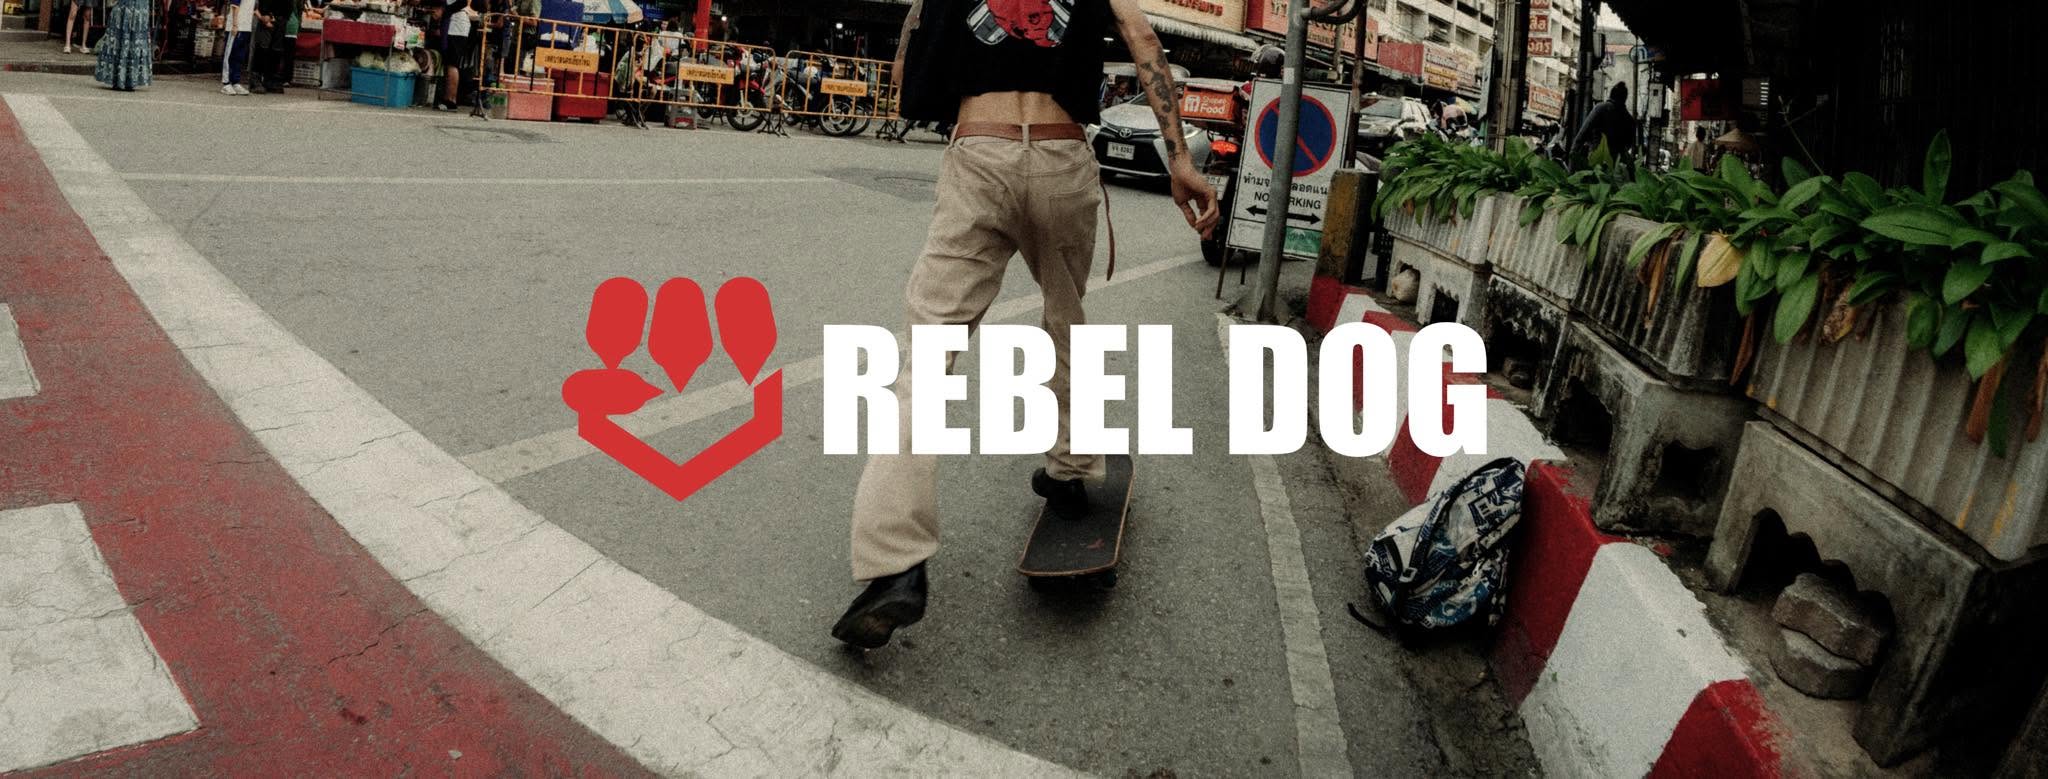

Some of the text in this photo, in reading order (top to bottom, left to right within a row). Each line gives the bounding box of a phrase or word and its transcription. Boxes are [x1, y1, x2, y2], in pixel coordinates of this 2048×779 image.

[1200, 103, 1226, 114] Food
[1254, 191, 1321, 210] NO RKING
